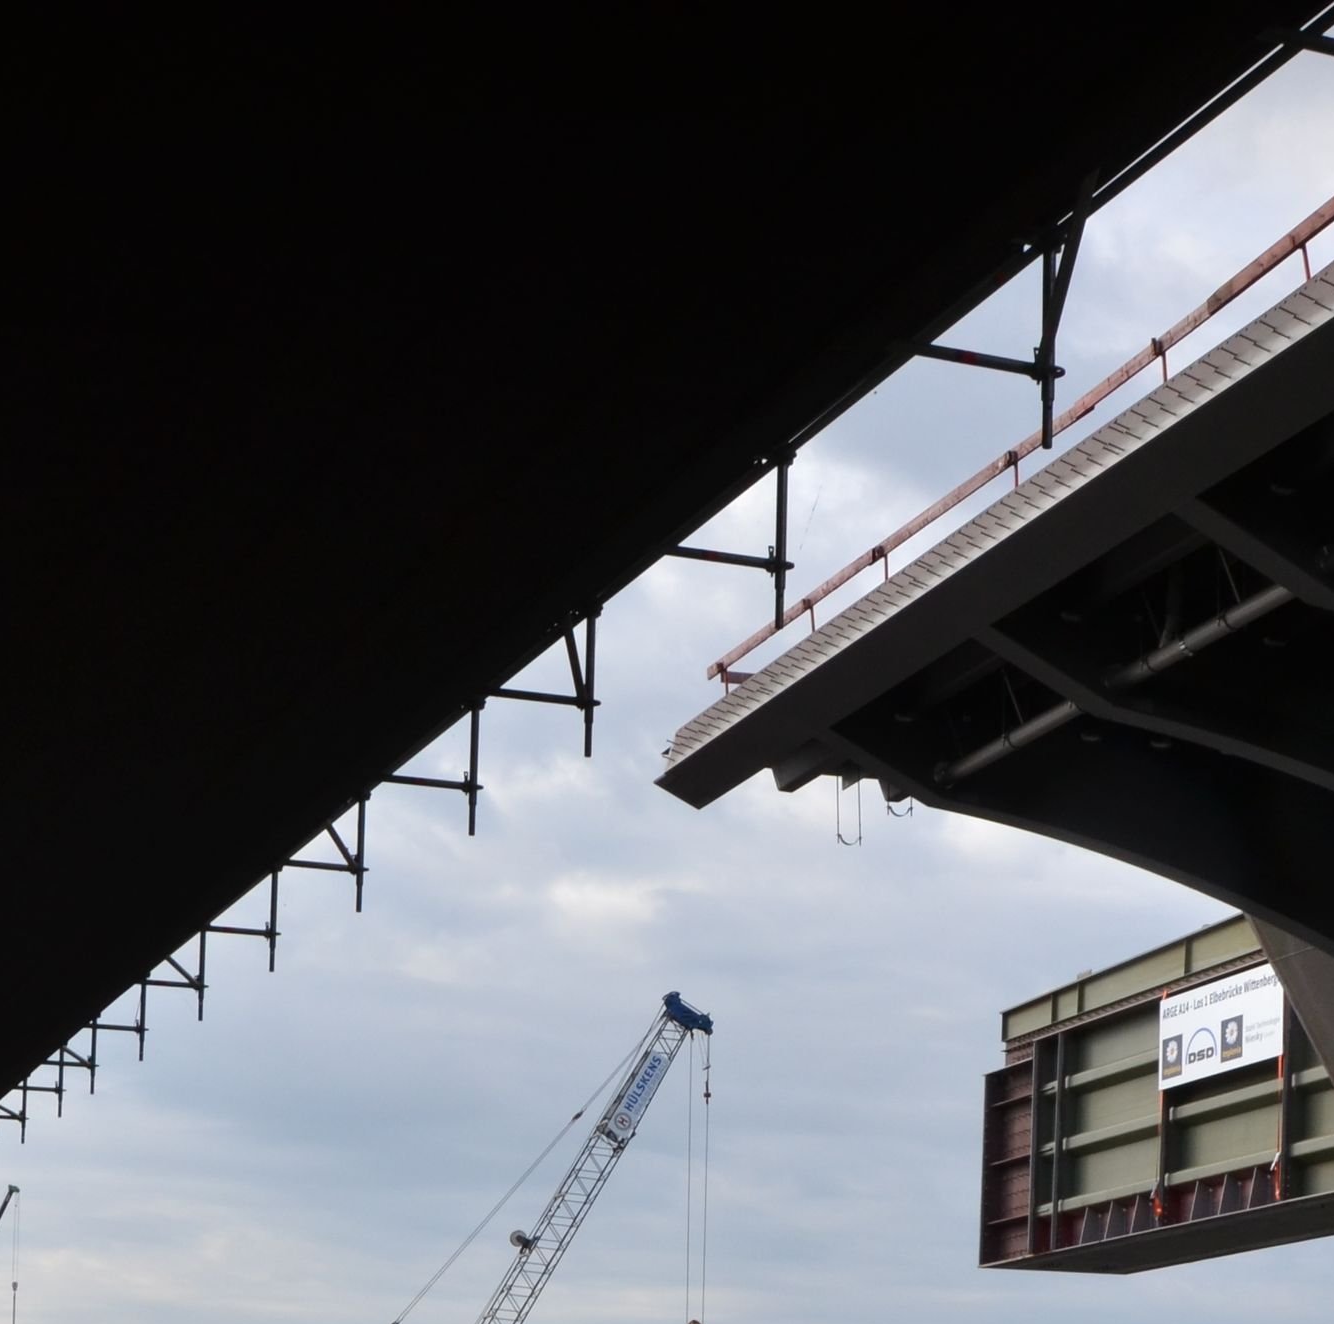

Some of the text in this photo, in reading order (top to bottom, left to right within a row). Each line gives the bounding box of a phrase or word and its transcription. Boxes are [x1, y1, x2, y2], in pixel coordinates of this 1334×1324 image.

[1162, 1003, 1178, 1018] ARGE
[1178, 1001, 1189, 1016] A14
[1209, 984, 1242, 1005] Elbebrücke
[1188, 1047, 1214, 1064] DSD
[624, 1055, 662, 1112] HÜLSKENS
